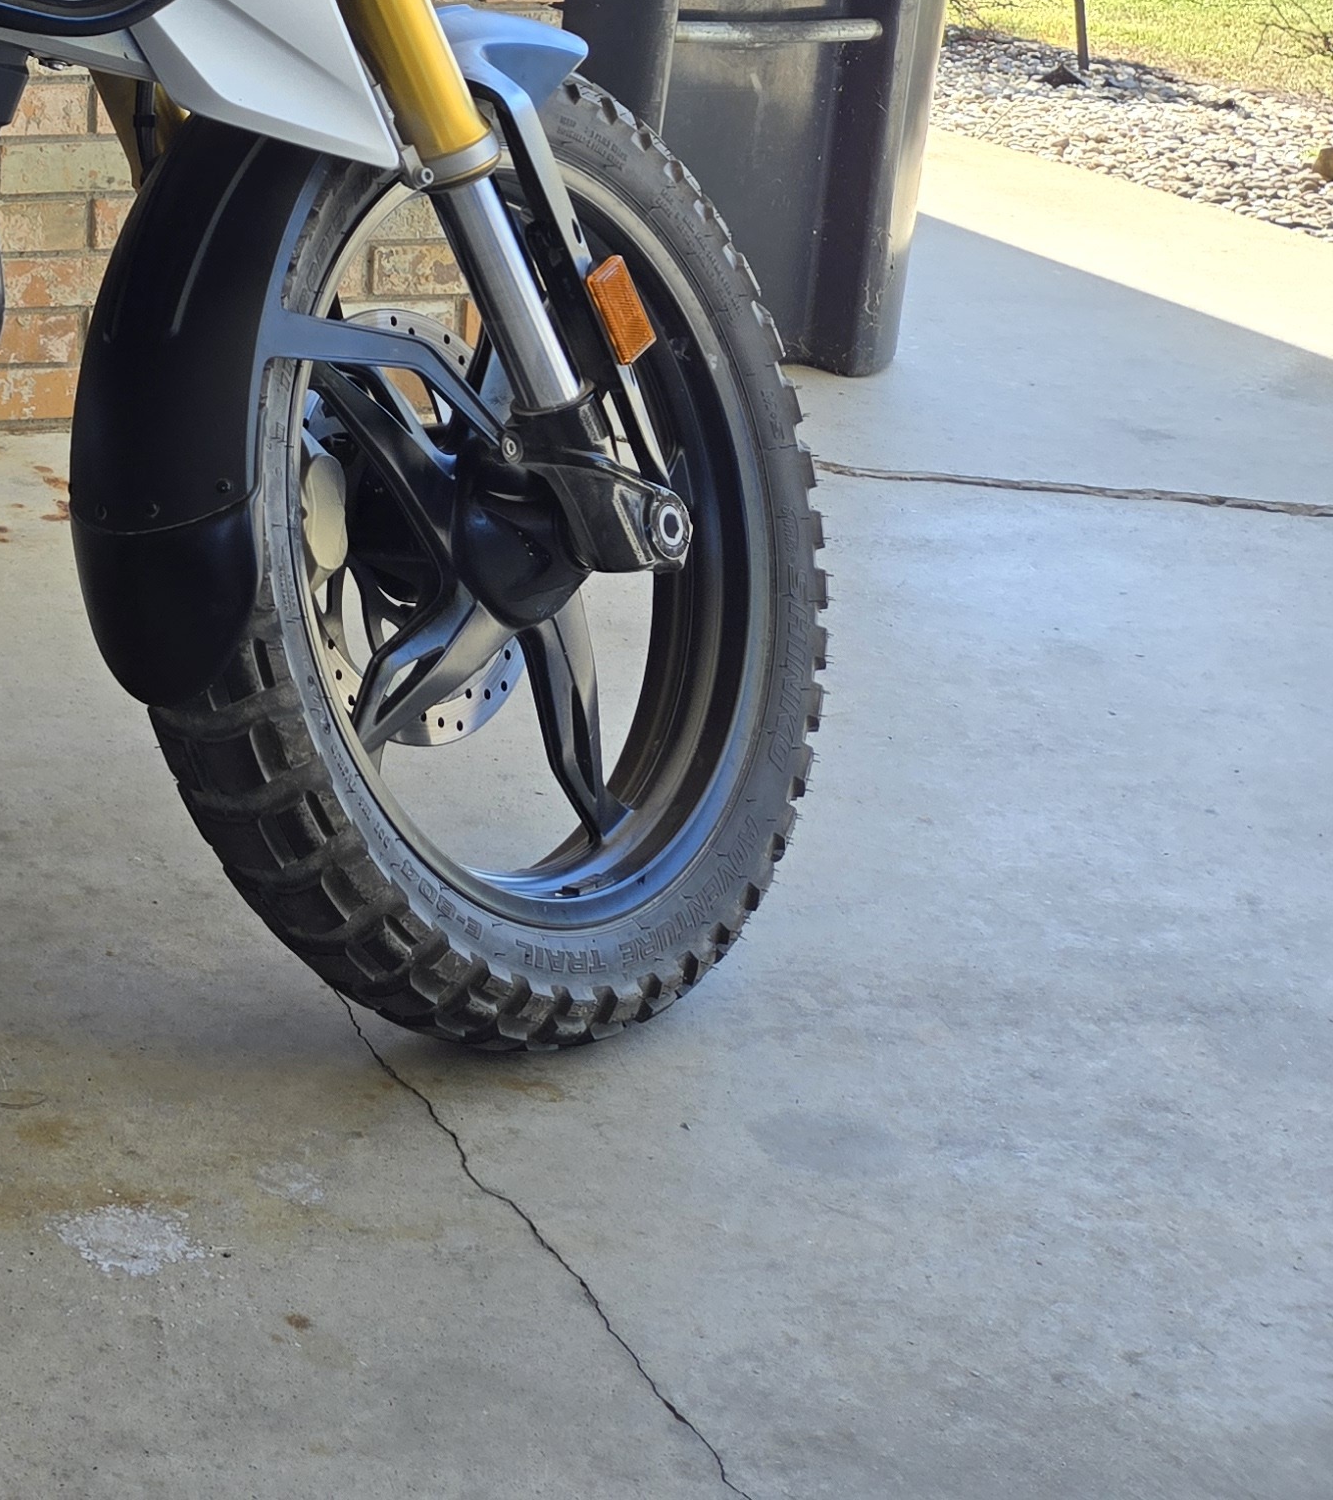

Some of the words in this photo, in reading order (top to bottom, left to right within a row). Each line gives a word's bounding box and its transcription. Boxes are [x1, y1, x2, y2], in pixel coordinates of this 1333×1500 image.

[767, 564, 810, 773] SHINKO
[399, 858, 483, 941] E-804
[620, 814, 761, 968] ADVENTURE
[515, 938, 609, 975] TRAIL
